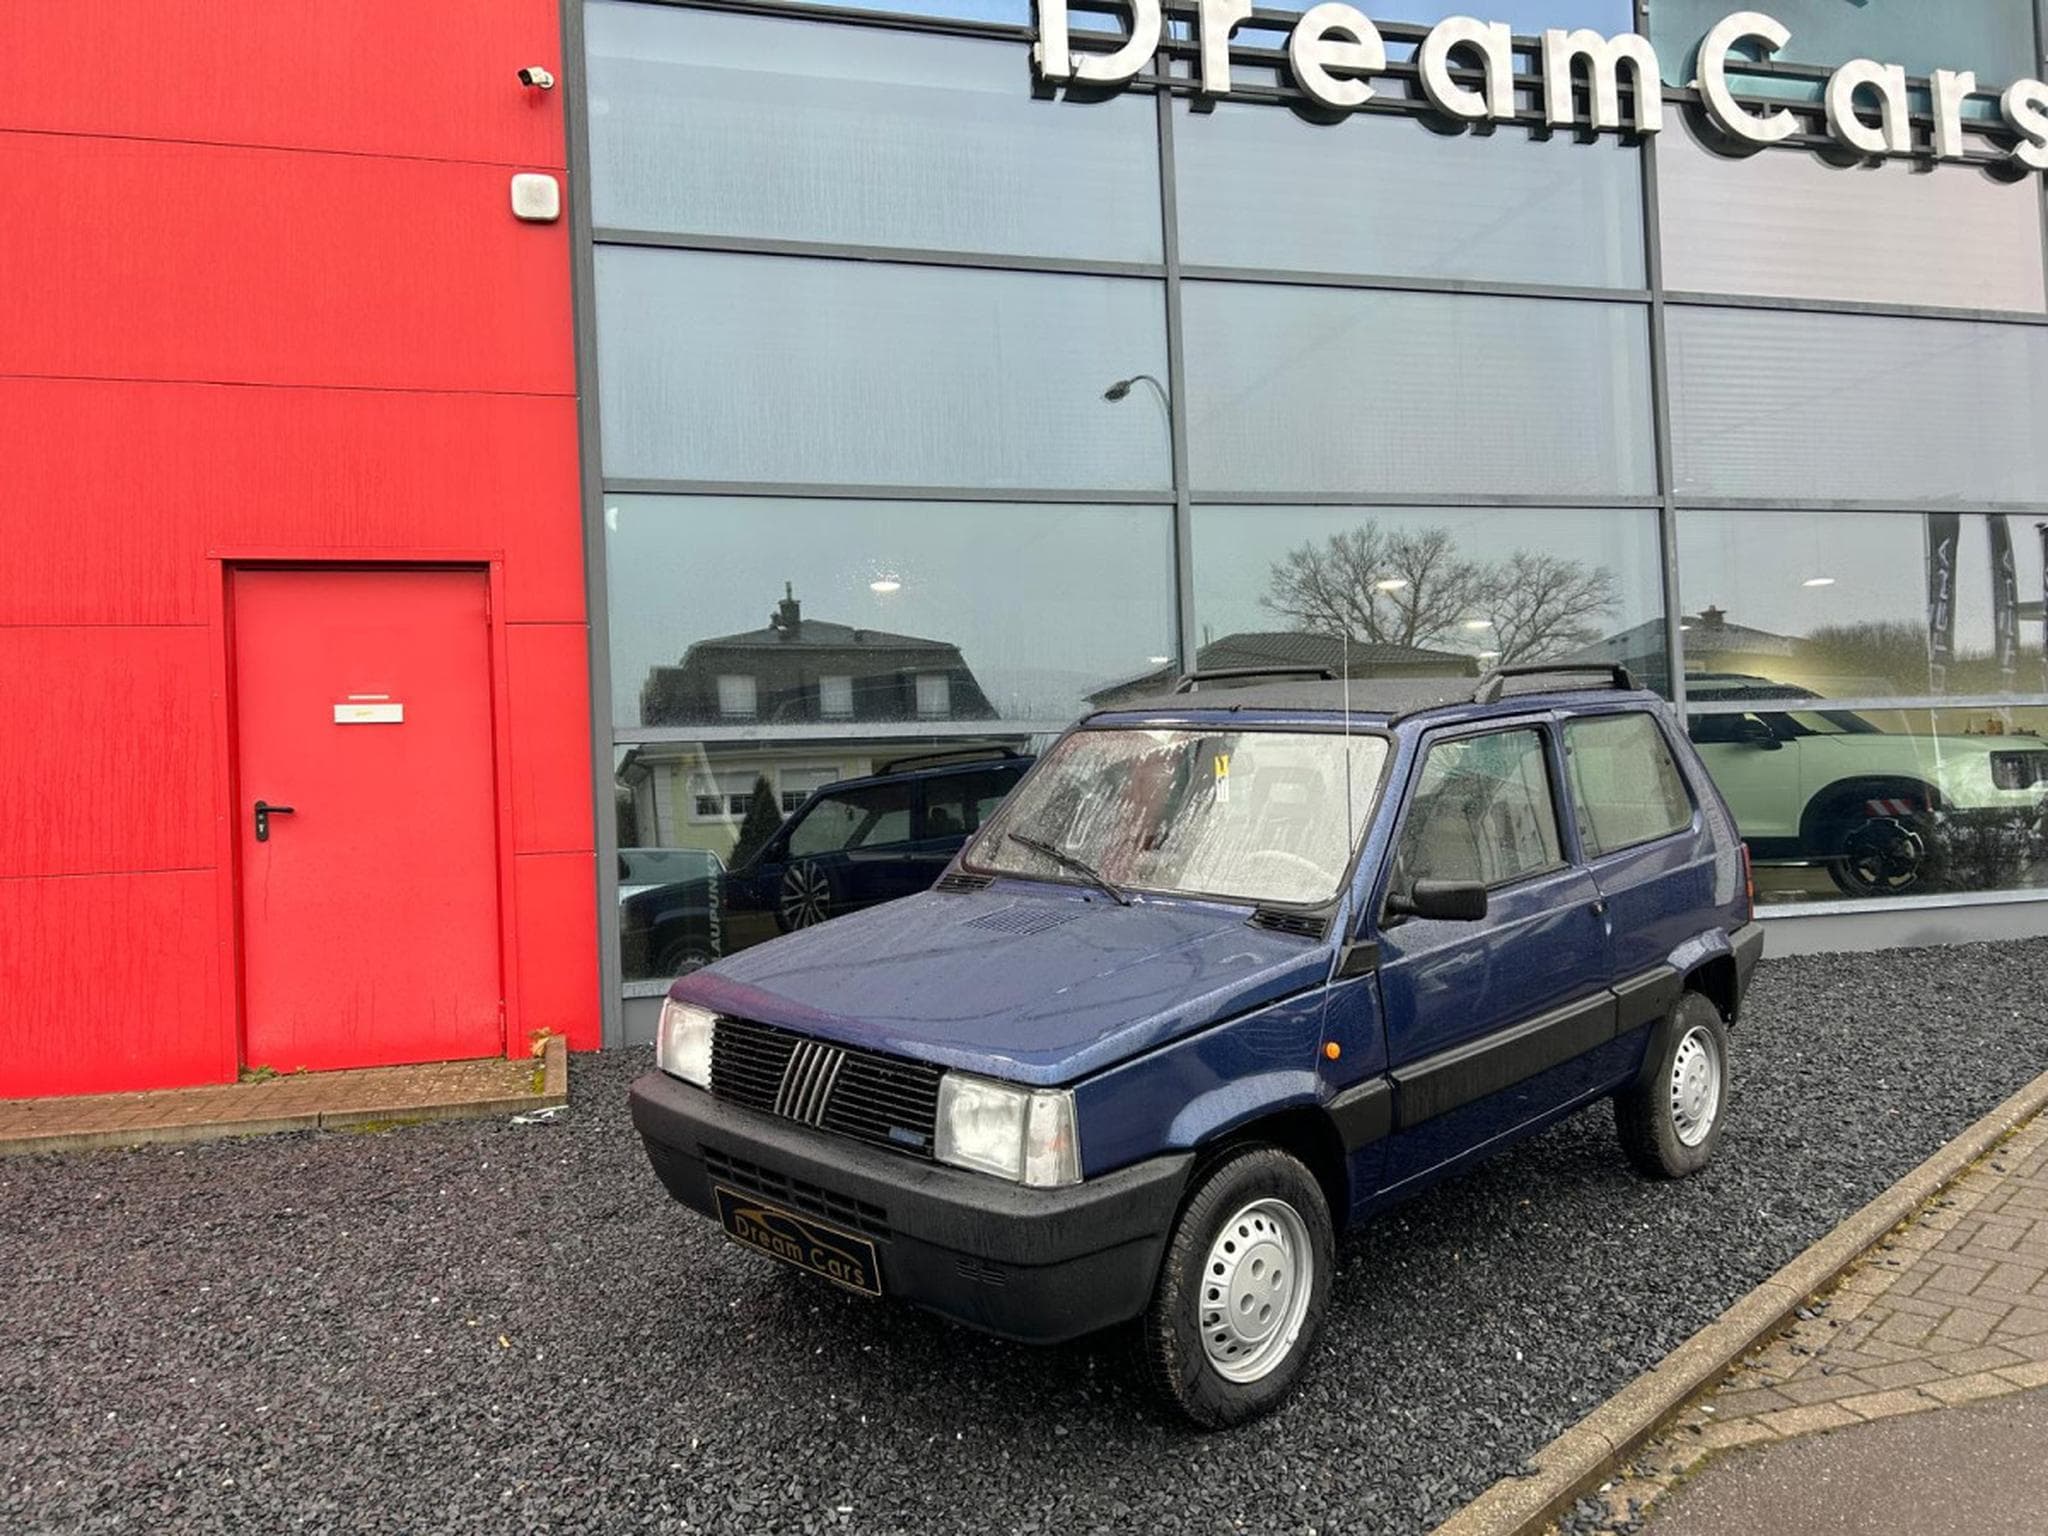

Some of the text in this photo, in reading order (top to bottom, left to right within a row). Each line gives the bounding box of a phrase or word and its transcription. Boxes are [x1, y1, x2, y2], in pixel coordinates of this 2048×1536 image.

[1033, 0, 2048, 169] Dream Cars
[734, 1214, 865, 1286] Dream Cars
